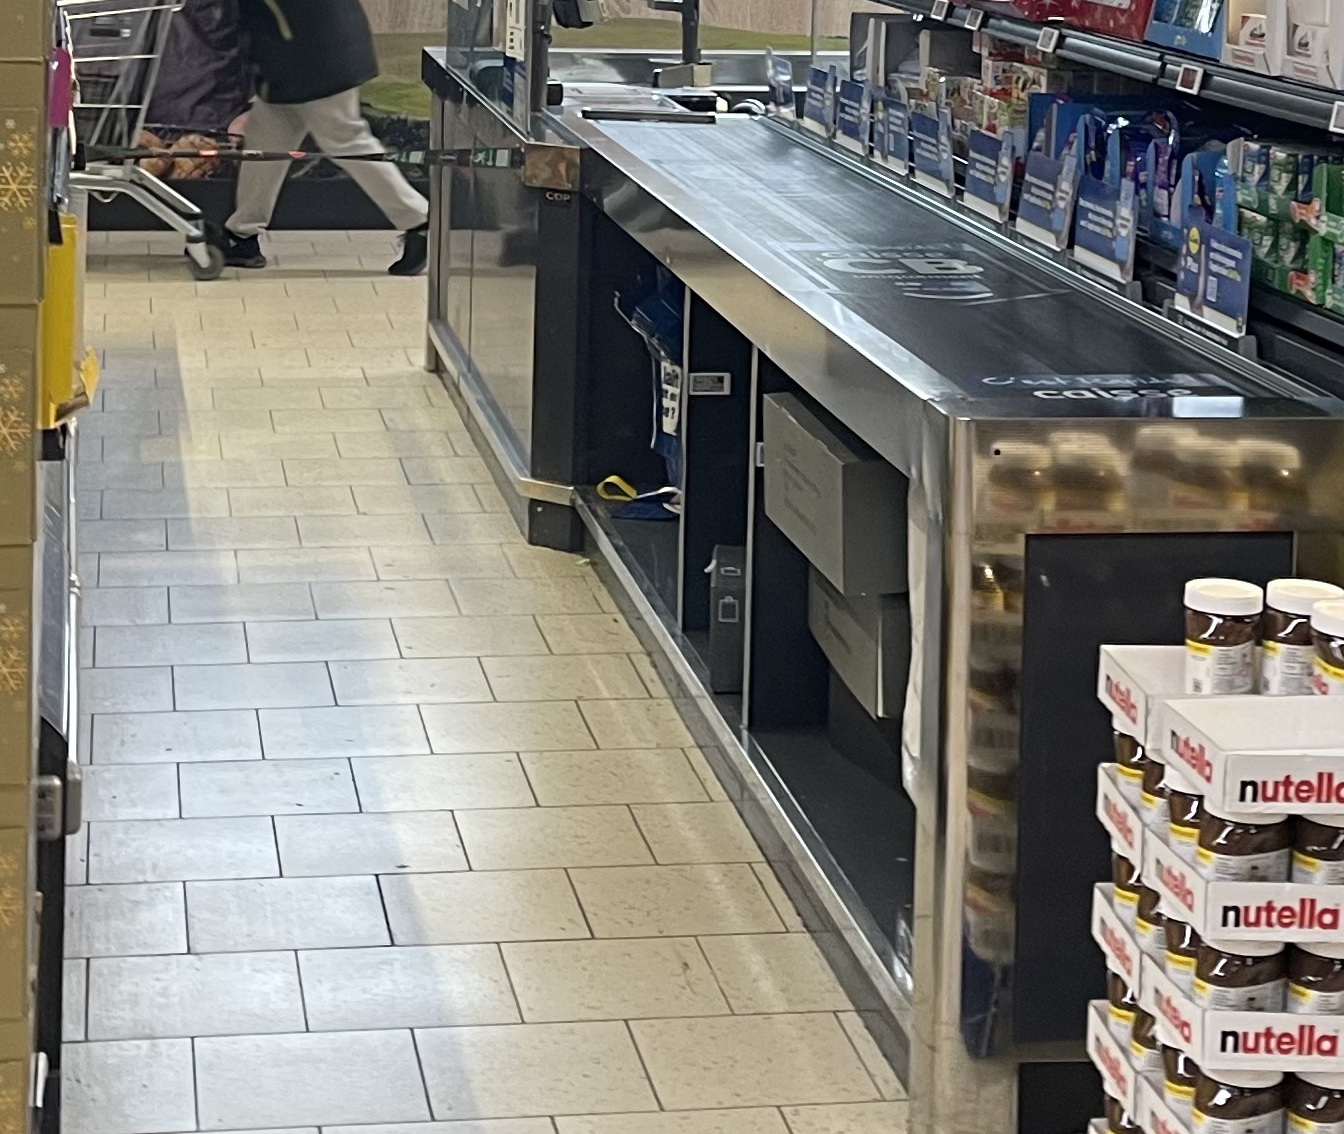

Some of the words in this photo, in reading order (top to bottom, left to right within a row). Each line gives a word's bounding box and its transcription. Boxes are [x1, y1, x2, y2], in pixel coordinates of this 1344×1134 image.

[823, 258, 985, 275] CB
[1033, 387, 1193, 401] caisse
[1221, 898, 1341, 930] nutella
[1220, 1024, 1339, 1057] nutella
